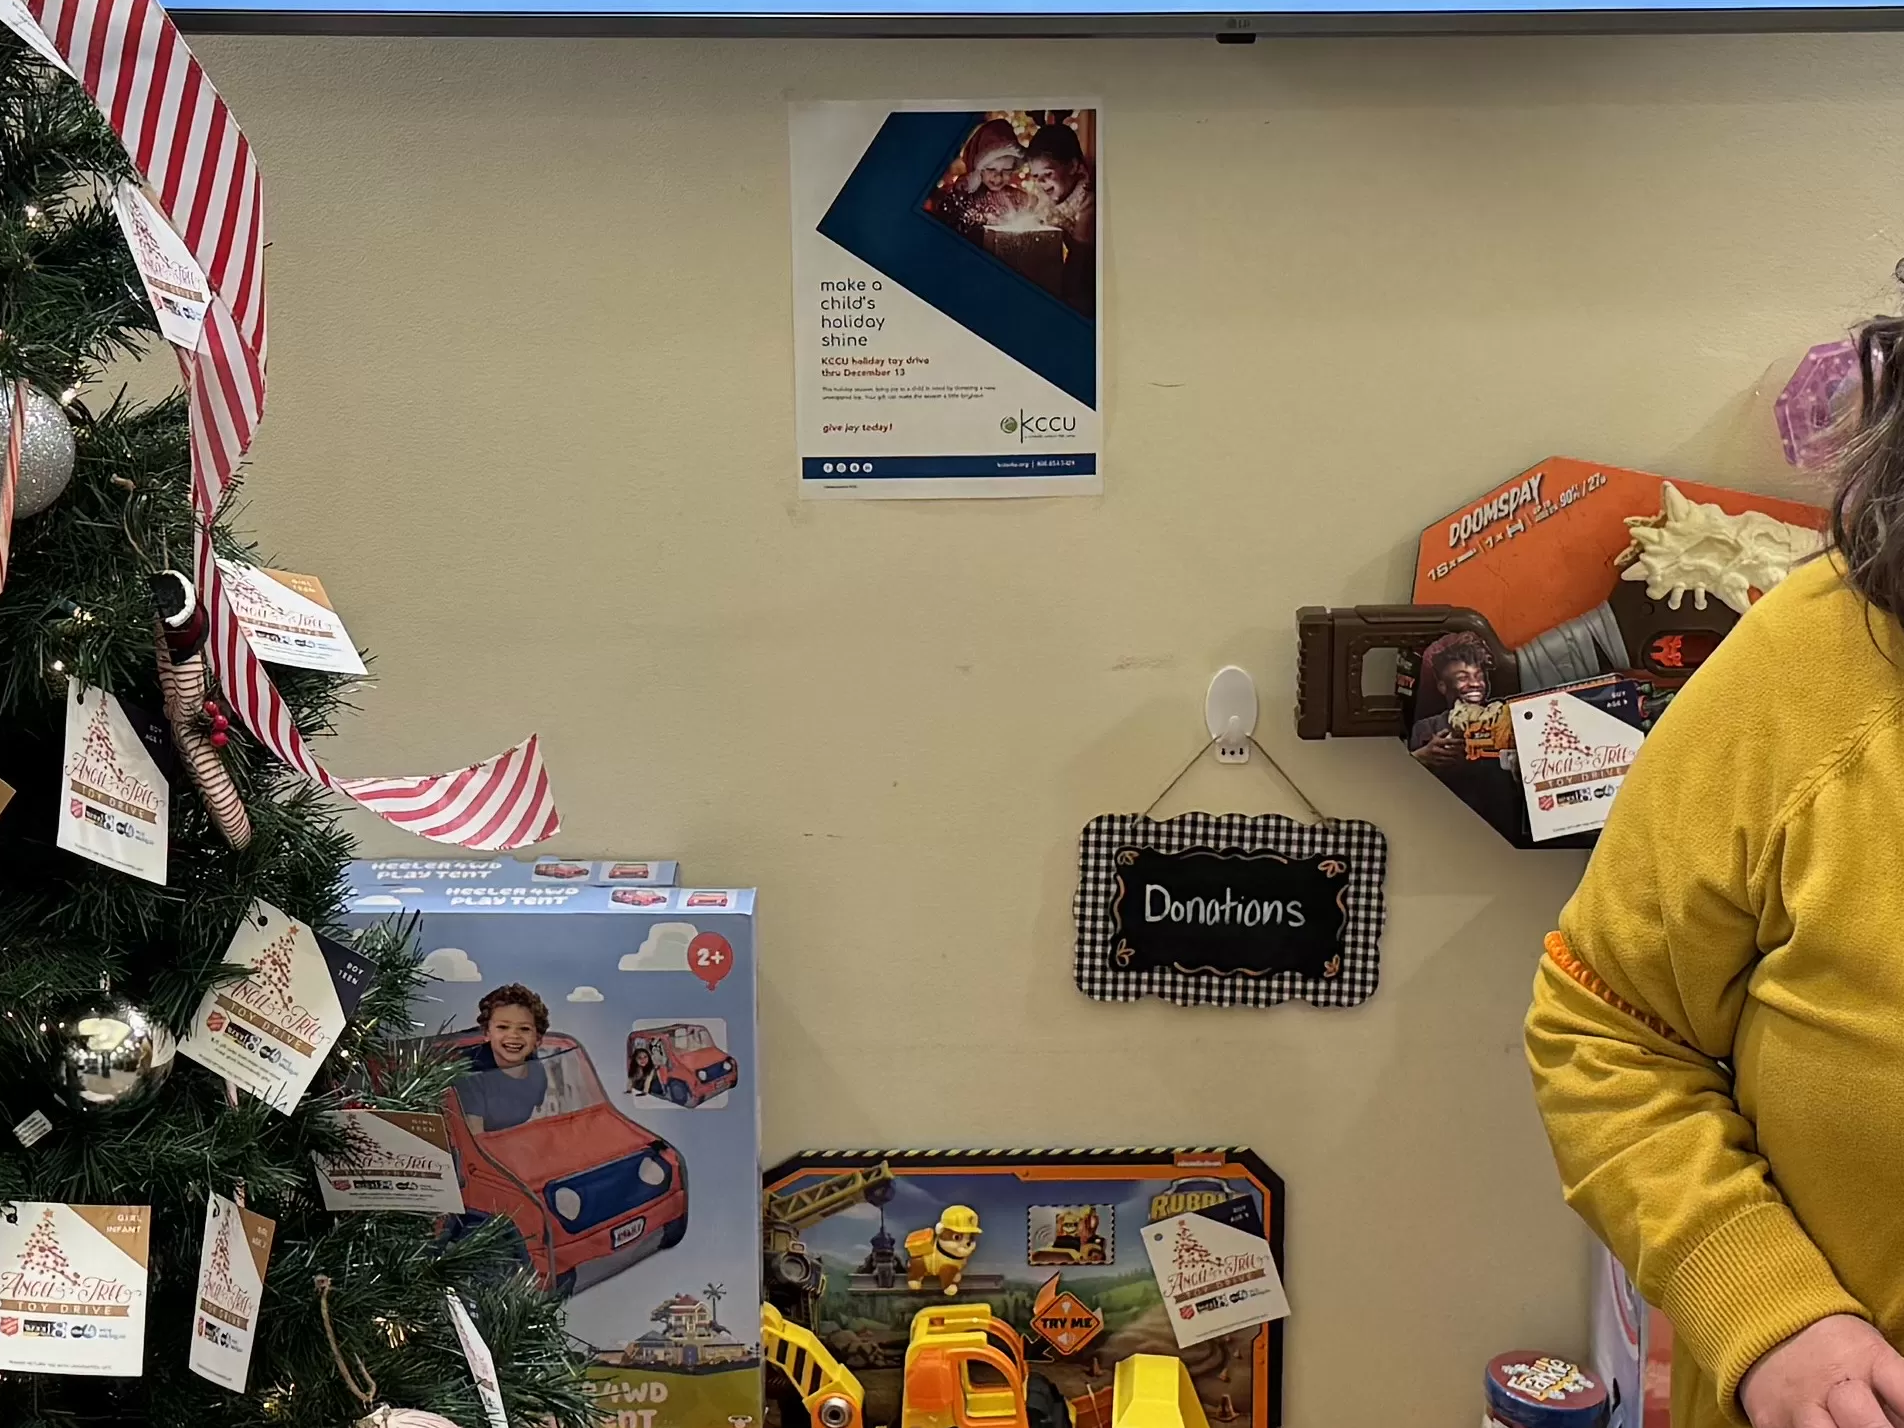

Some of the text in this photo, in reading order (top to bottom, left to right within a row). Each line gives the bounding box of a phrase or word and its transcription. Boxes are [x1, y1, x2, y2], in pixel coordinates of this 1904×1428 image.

[820, 277, 882, 292] make a
[820, 296, 876, 310] child's
[821, 315, 885, 331] holiday
[821, 333, 868, 347] shine
[821, 357, 849, 366] KCCU
[851, 356, 885, 367] holiday
[888, 357, 903, 367] toy
[821, 368, 906, 377] thru December 13
[822, 423, 893, 434] give joy today!
[1448, 472, 1545, 549] DOOMSDAY
[1145, 884, 1306, 927] Donations
[696, 948, 725, 967] 2+
[117, 1213, 143, 1223] GIRL
[106, 1226, 142, 1234] INFANT
[17, 1301, 114, 1315] TOY DRIVE
[1040, 1316, 1093, 1330] TRY ME
